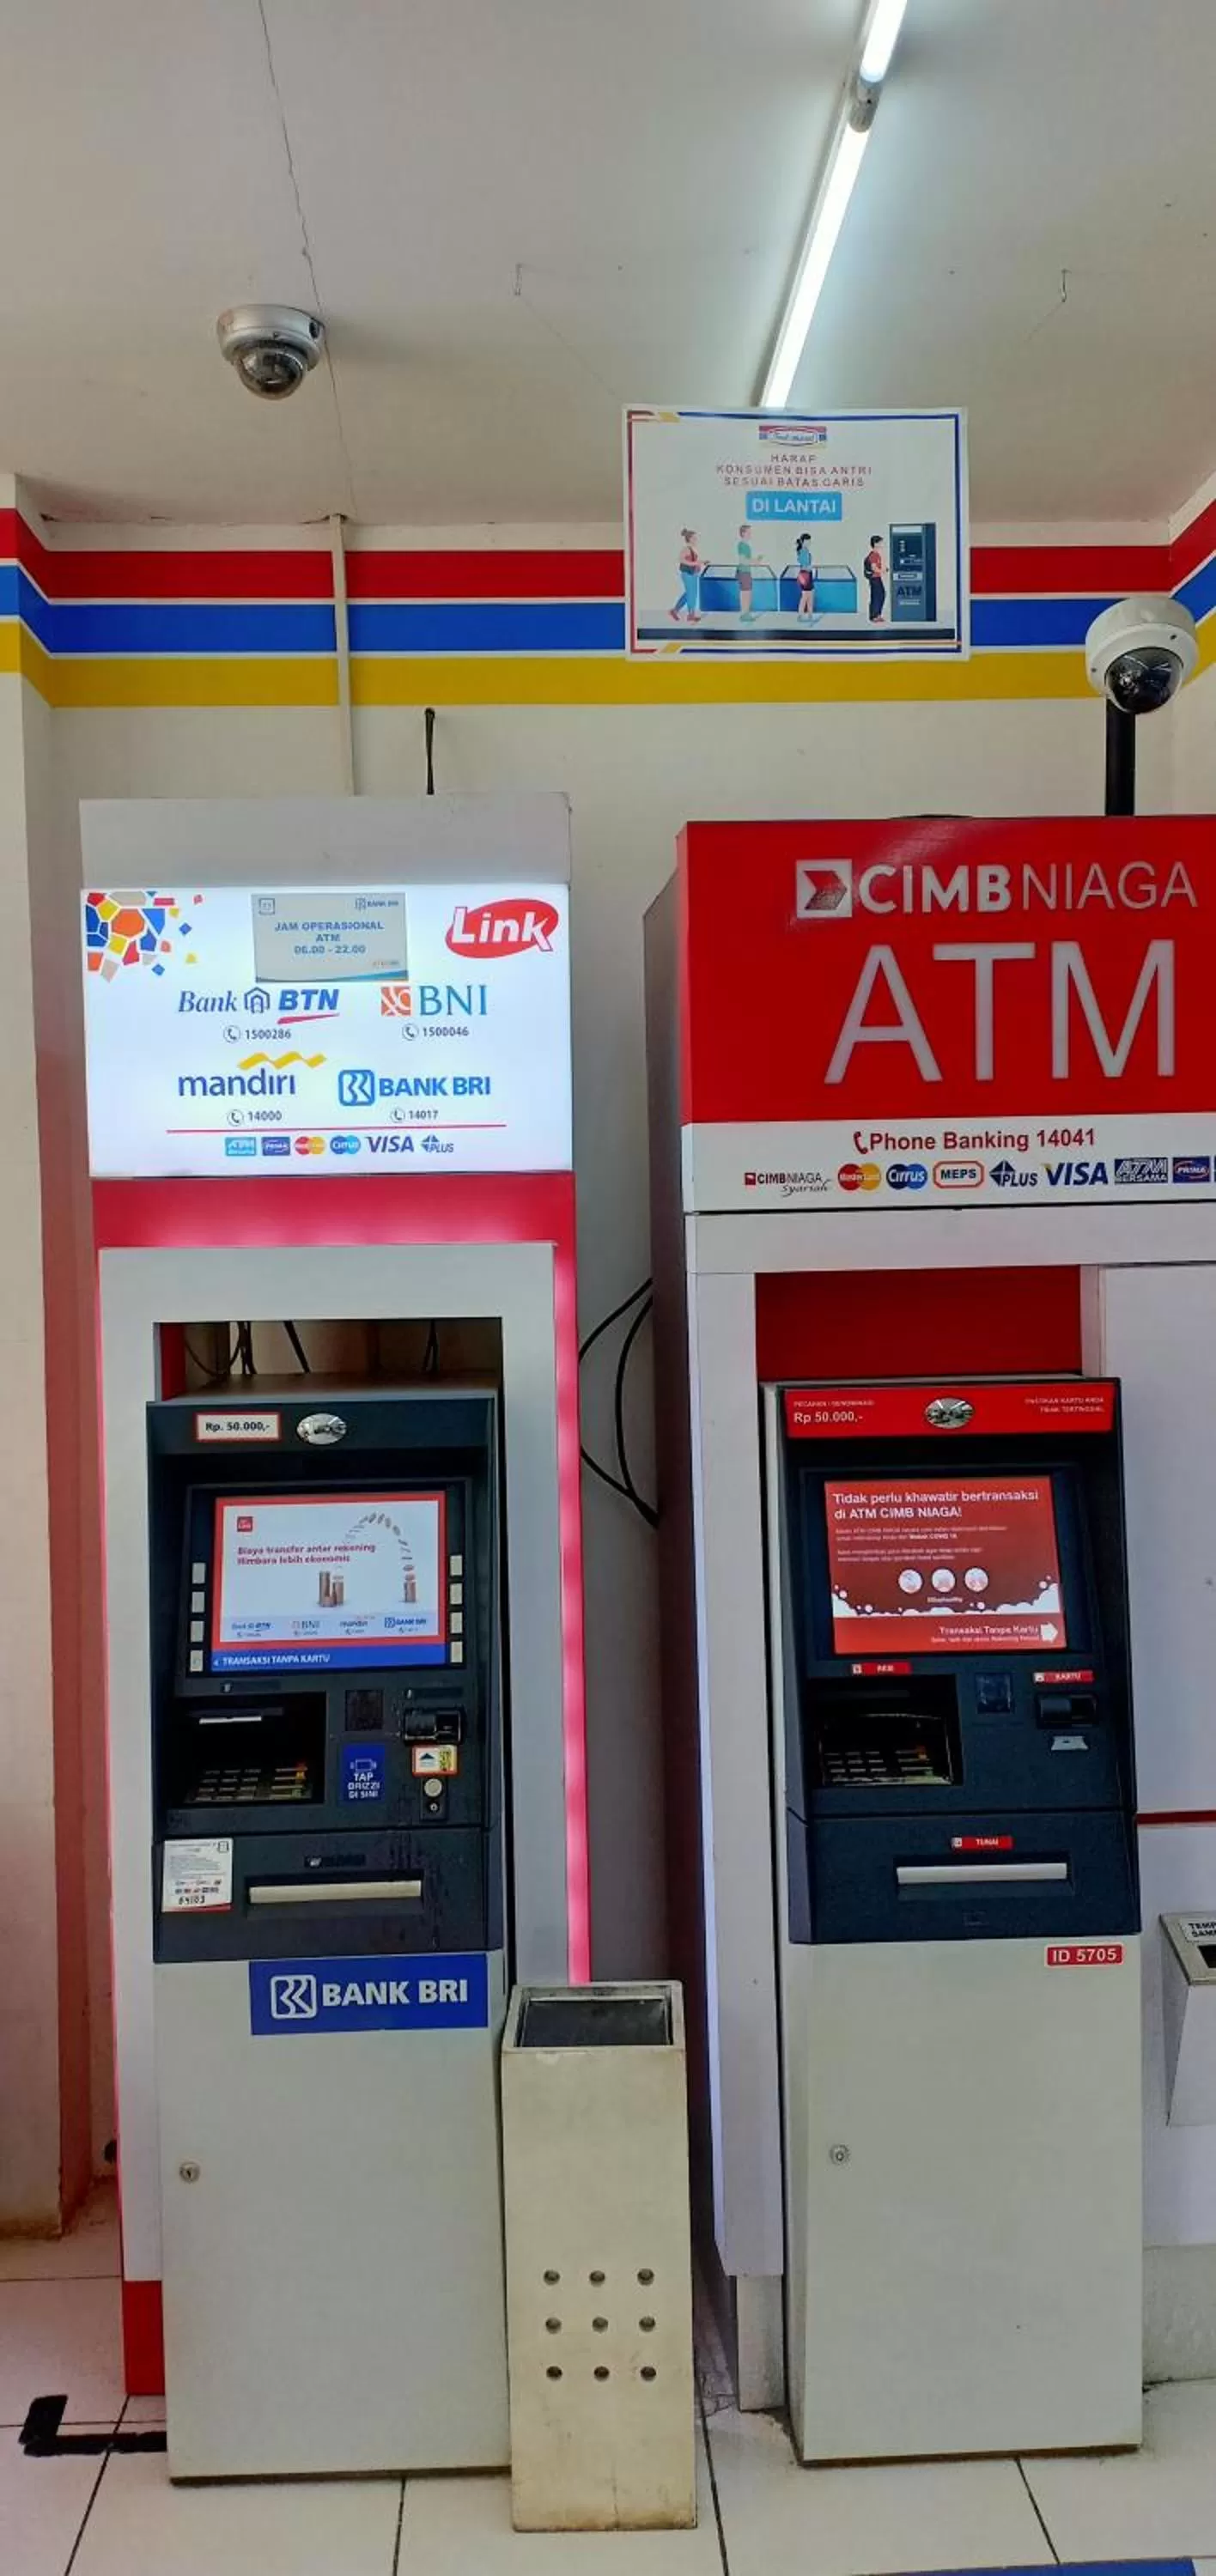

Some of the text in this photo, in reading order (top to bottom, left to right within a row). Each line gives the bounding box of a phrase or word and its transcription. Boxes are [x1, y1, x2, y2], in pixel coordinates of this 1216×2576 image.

[716, 465, 872, 476] KONSUMEN BISA ANTRI
[724, 477, 866, 488] SESUAI BATAS GARIS
[751, 498, 836, 513] DI LANTAI
[274, 920, 385, 932] JAM OPERASIONAL
[451, 905, 554, 952] Link
[315, 933, 341, 942] ATM
[335, 945, 367, 954] 22.00
[178, 990, 237, 1012] Bank
[277, 988, 340, 1011] BTN
[419, 985, 488, 1016] BNI
[823, 939, 1176, 1084] ATM
[245, 1029, 291, 1040] 1500286
[422, 1026, 470, 1037] 1500046
[178, 1067, 296, 1097] mandiri
[379, 1076, 491, 1097] BANK BRI
[247, 1110, 283, 1121] 14000
[408, 1109, 439, 1120] 14017
[365, 1135, 415, 1152] VISA
[870, 1128, 1095, 1152] Phone Banking 14041
[430, 1142, 454, 1152] PLUS
[888, 1166, 927, 1183] Cirrus
[940, 1169, 977, 1180] MEPS
[1001, 1171, 1038, 1187] PLUS
[1044, 1162, 1109, 1186] VISA
[793, 1412, 812, 1425] Rp
[205, 1421, 271, 1432] Rp. 50.000,-
[833, 1491, 1039, 1506] Tidak perlu khawatir bertransaksi
[834, 1507, 962, 1519] di ATM CIMB NIAGA!
[237, 1546, 263, 1557] Biaya
[266, 1546, 303, 1555] transfer
[334, 1544, 375, 1554] rekening
[279, 1555, 303, 1564] lebih
[222, 1654, 331, 1666] TRANSAKSI TANPA KARTU
[353, 1771, 374, 1782] TAP
[976, 1838, 1000, 1846] TUNAI
[1053, 1947, 1117, 1962] ID 5705
[321, 1978, 469, 2007] BANK BRI
